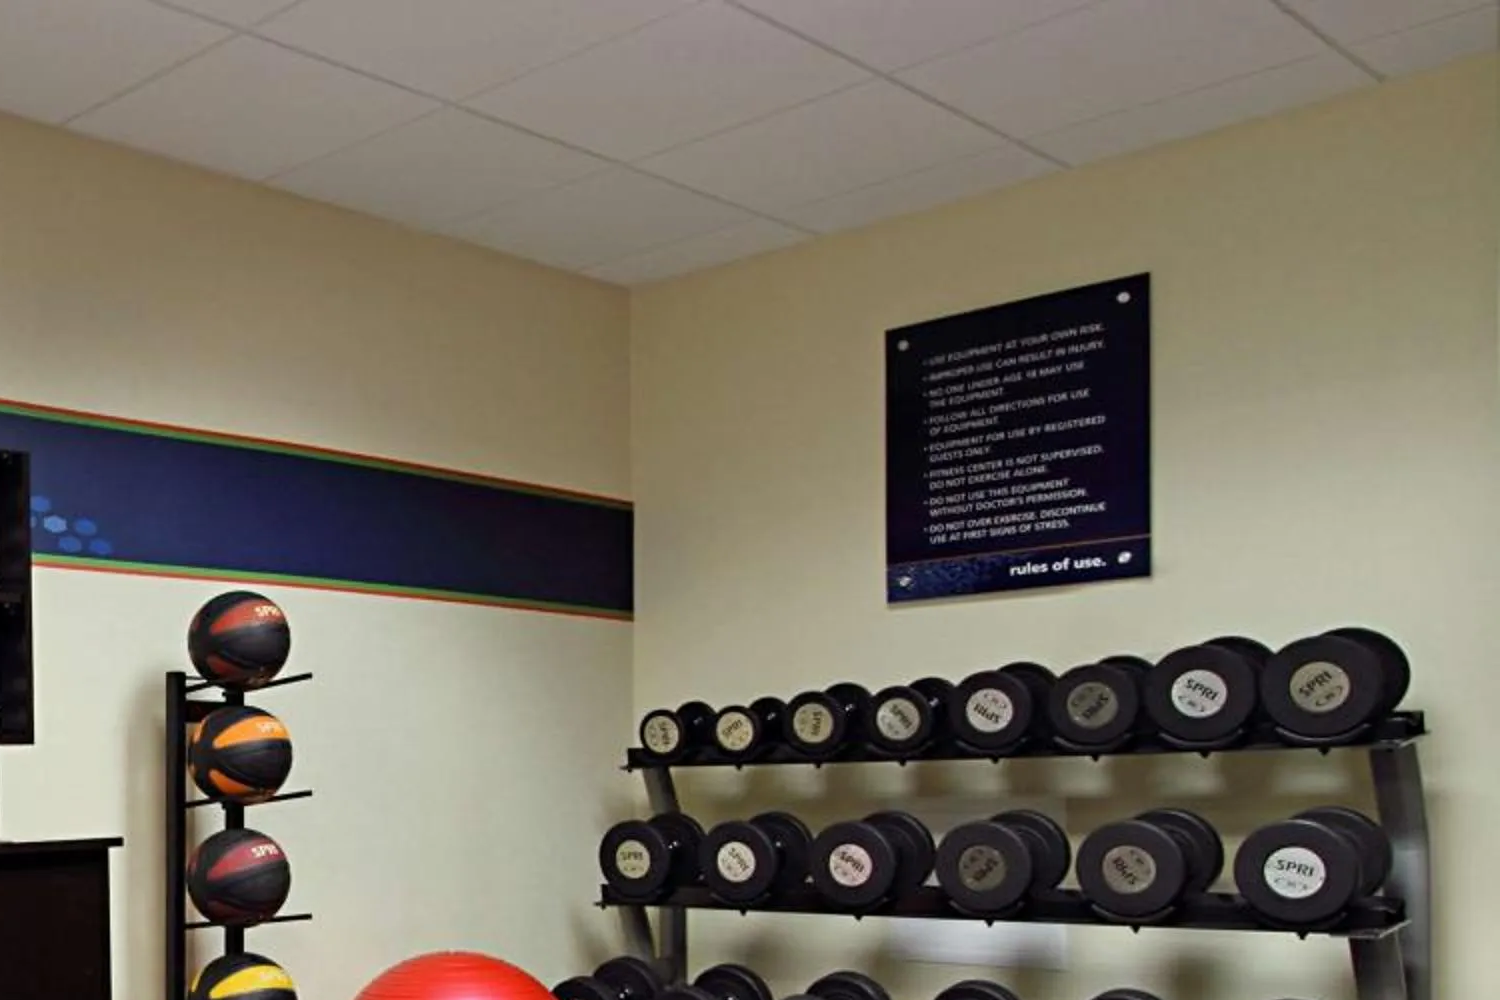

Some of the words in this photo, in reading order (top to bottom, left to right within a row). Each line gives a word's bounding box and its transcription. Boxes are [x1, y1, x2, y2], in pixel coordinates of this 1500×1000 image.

[929, 435, 985, 453] EQUIPMENT
[1044, 415, 1106, 433] REGISTERED
[1016, 453, 1039, 465] NOT
[929, 479, 944, 491] DO
[945, 476, 966, 488] NOT
[967, 469, 1011, 485] EXERCISE
[929, 495, 944, 506] DO
[945, 492, 966, 504] NOT
[967, 489, 986, 501] USE
[988, 485, 1009, 497] THIS
[1011, 477, 1071, 495] EQUIPMENT
[929, 502, 973, 517] WITHOUT
[929, 522, 944, 534] DO
[945, 519, 965, 531] NOT
[966, 516, 992, 529] OVER
[1039, 500, 1106, 519] DISCONTINUE
[963, 527, 988, 540] FIRST
[1019, 522, 1033, 534] OF
[1009, 561, 1049, 576] rules
[1051, 557, 1071, 571] of
[1073, 557, 1107, 569] use.
[1185, 678, 1220, 701] SPRI
[1298, 669, 1333, 698] SPRI
[810, 710, 823, 737] SPRI
[889, 703, 913, 730] SPRI
[973, 703, 1001, 726] SPRI
[619, 851, 644, 862] SPRI
[728, 847, 750, 872] SPRI
[839, 850, 866, 874] SPRI
[1275, 857, 1315, 878] SPRI
[1112, 855, 1138, 886] SPRI
